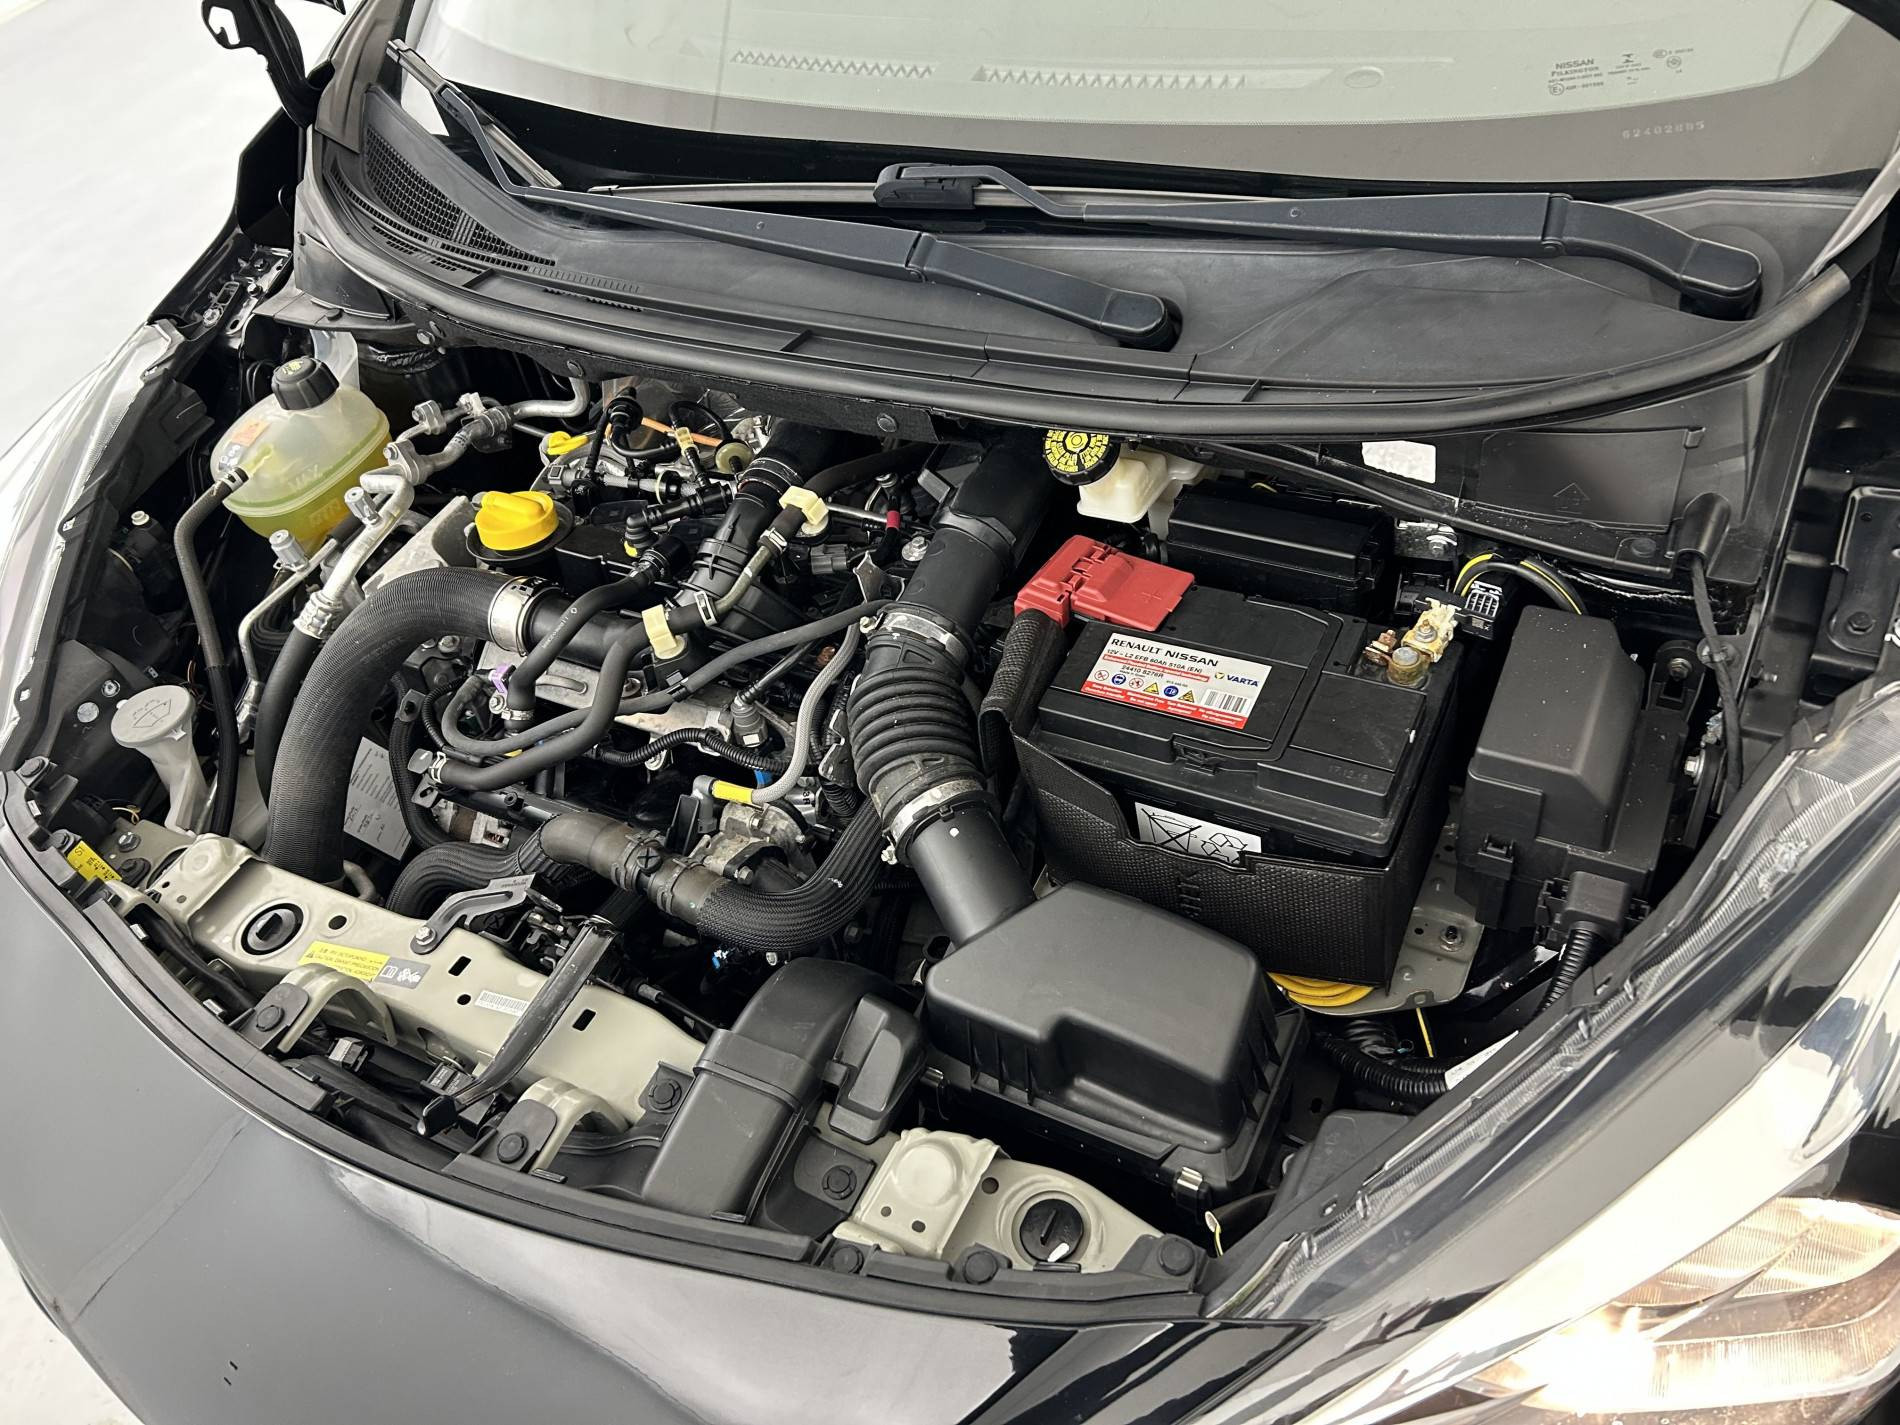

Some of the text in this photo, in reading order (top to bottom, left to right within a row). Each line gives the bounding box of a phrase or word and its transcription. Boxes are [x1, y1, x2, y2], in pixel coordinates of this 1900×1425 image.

[1555, 58, 1594, 70] NISSAN
[1111, 638, 1219, 667] RENAULT NISSAN
[1134, 654, 1149, 662] EFB
[1187, 665, 1203, 674] (EN)
[1226, 674, 1259, 687] VARTA
